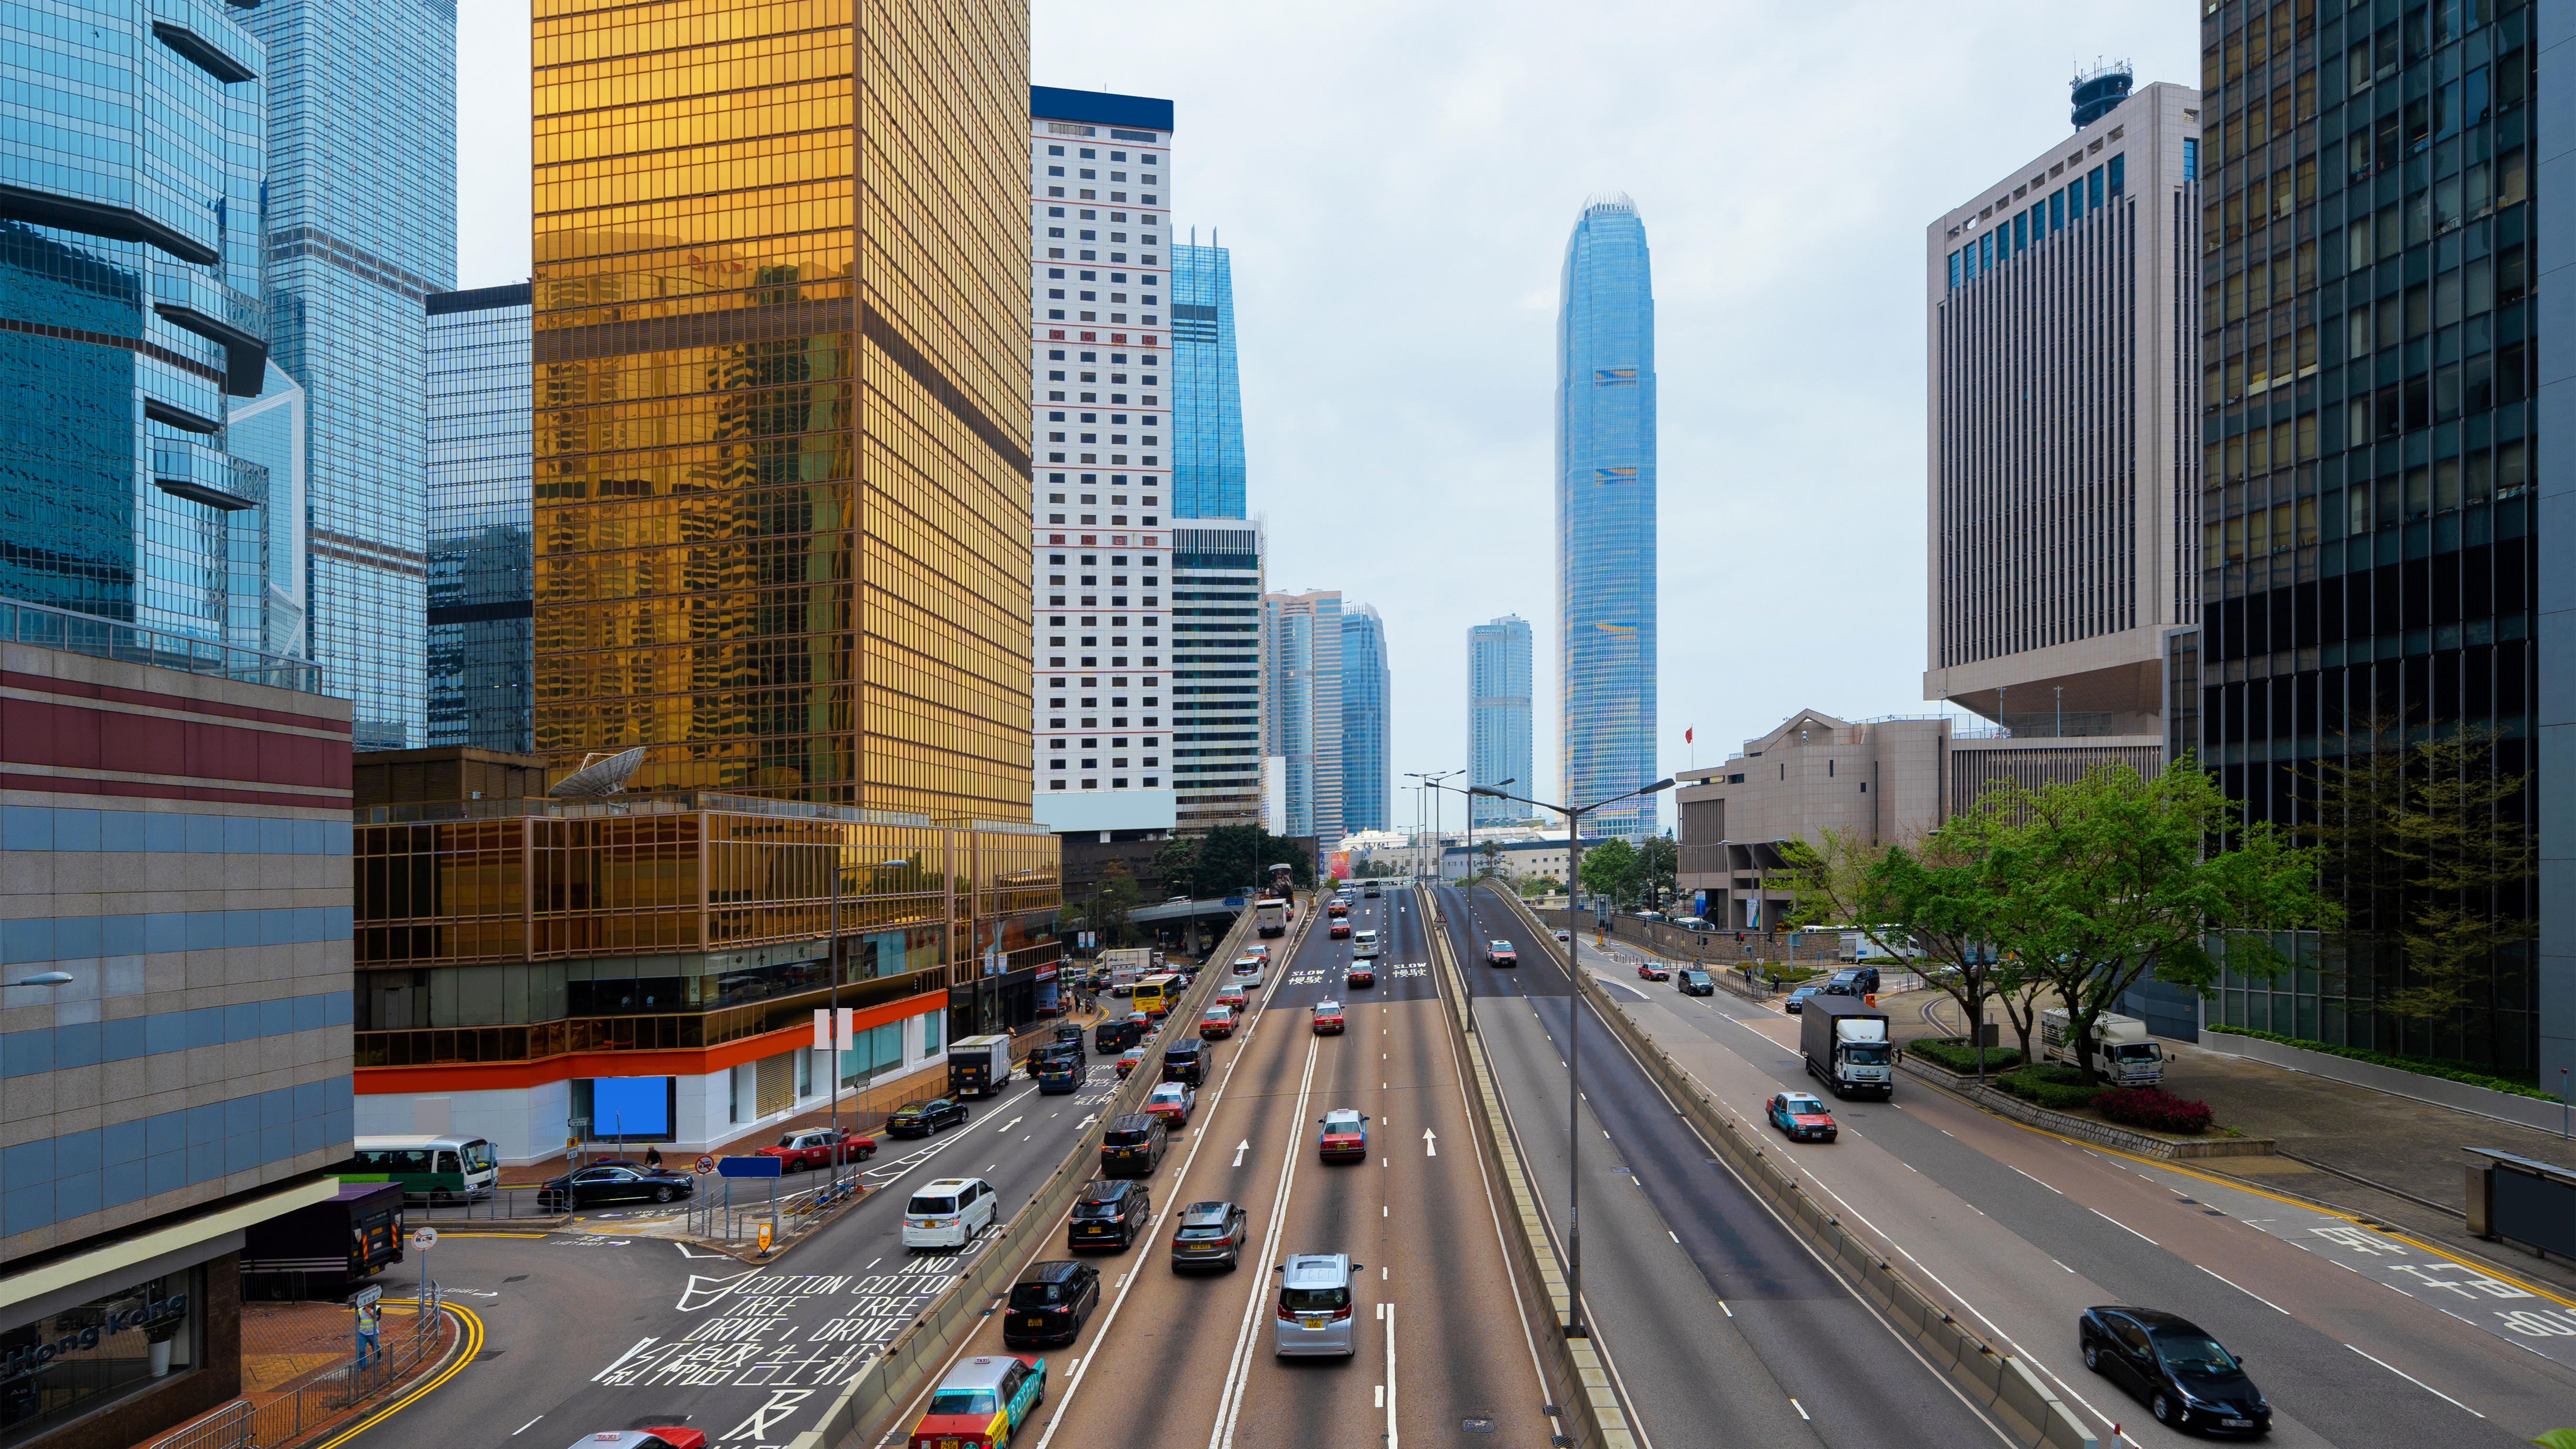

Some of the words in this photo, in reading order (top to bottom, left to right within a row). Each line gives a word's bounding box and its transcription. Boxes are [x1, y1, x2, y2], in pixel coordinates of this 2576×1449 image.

[1288, 976, 1323, 986] 慢駛
[1392, 969, 1427, 978] 慢駛
[897, 1257, 959, 1274] AND
[733, 1275, 854, 1295] COTTON
[722, 1296, 811, 1317] TREE
[845, 1296, 929, 1317] TREE
[7, 1325, 100, 1375] Hong
[107, 1293, 188, 1336] Kong
[681, 1318, 789, 1342] DRIVE
[807, 1318, 912, 1342] DRIVE
[601, 1342, 765, 1387] 紅棉路
[1011, 1374, 1039, 1422] BOXFUL
[718, 1389, 817, 1440] 及
